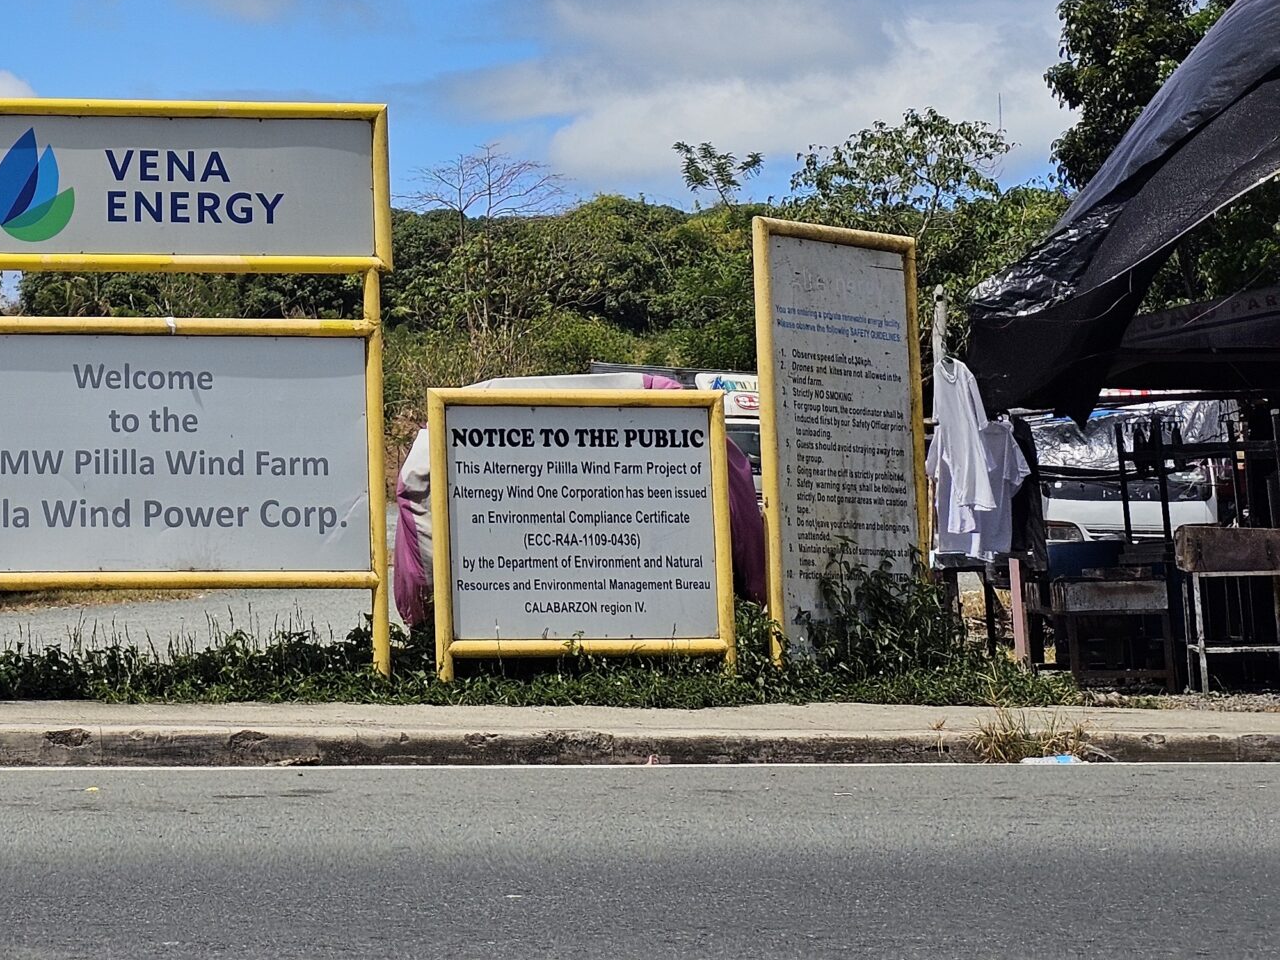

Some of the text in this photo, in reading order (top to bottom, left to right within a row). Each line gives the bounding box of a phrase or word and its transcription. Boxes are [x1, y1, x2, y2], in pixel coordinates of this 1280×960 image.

[105, 149, 230, 182] VENA
[107, 191, 285, 224] ENERGY
[73, 363, 213, 390] Welcome
[792, 361, 813, 373] Drones
[816, 364, 827, 374] and
[853, 369, 863, 378] not
[864, 370, 886, 380] allowed
[792, 387, 814, 400] Strictly
[814, 389, 824, 399] NO
[109, 407, 198, 433] to the
[451, 428, 704, 447] NOTICE TO THE PUBLIC
[796, 439, 815, 450] Guests
[815, 441, 837, 452] should
[837, 443, 852, 453] avoid
[852, 444, 876, 456] straying
[876, 448, 891, 458] away
[0, 451, 64, 474] MW
[75, 449, 155, 475] Pililla
[165, 450, 245, 475] Wind
[256, 451, 329, 476] Farm
[455, 461, 702, 477] This Alternergy Pililla Wind Farm Project of
[453, 486, 707, 501] Alternegy Wind One Corporation has been issued
[41, 499, 131, 528] Wind
[144, 500, 249, 528] Power
[260, 500, 348, 534] Corp.
[472, 511, 690, 526] an Environmental Compliance Certificate
[523, 533, 641, 549] (ECC-R4A-1109-0436)
[462, 555, 703, 572] by the Department of Environment and Natural
[457, 579, 711, 592] Resources and Environmental Management Bureau
[525, 601, 647, 615] CALABARZON region IV.
